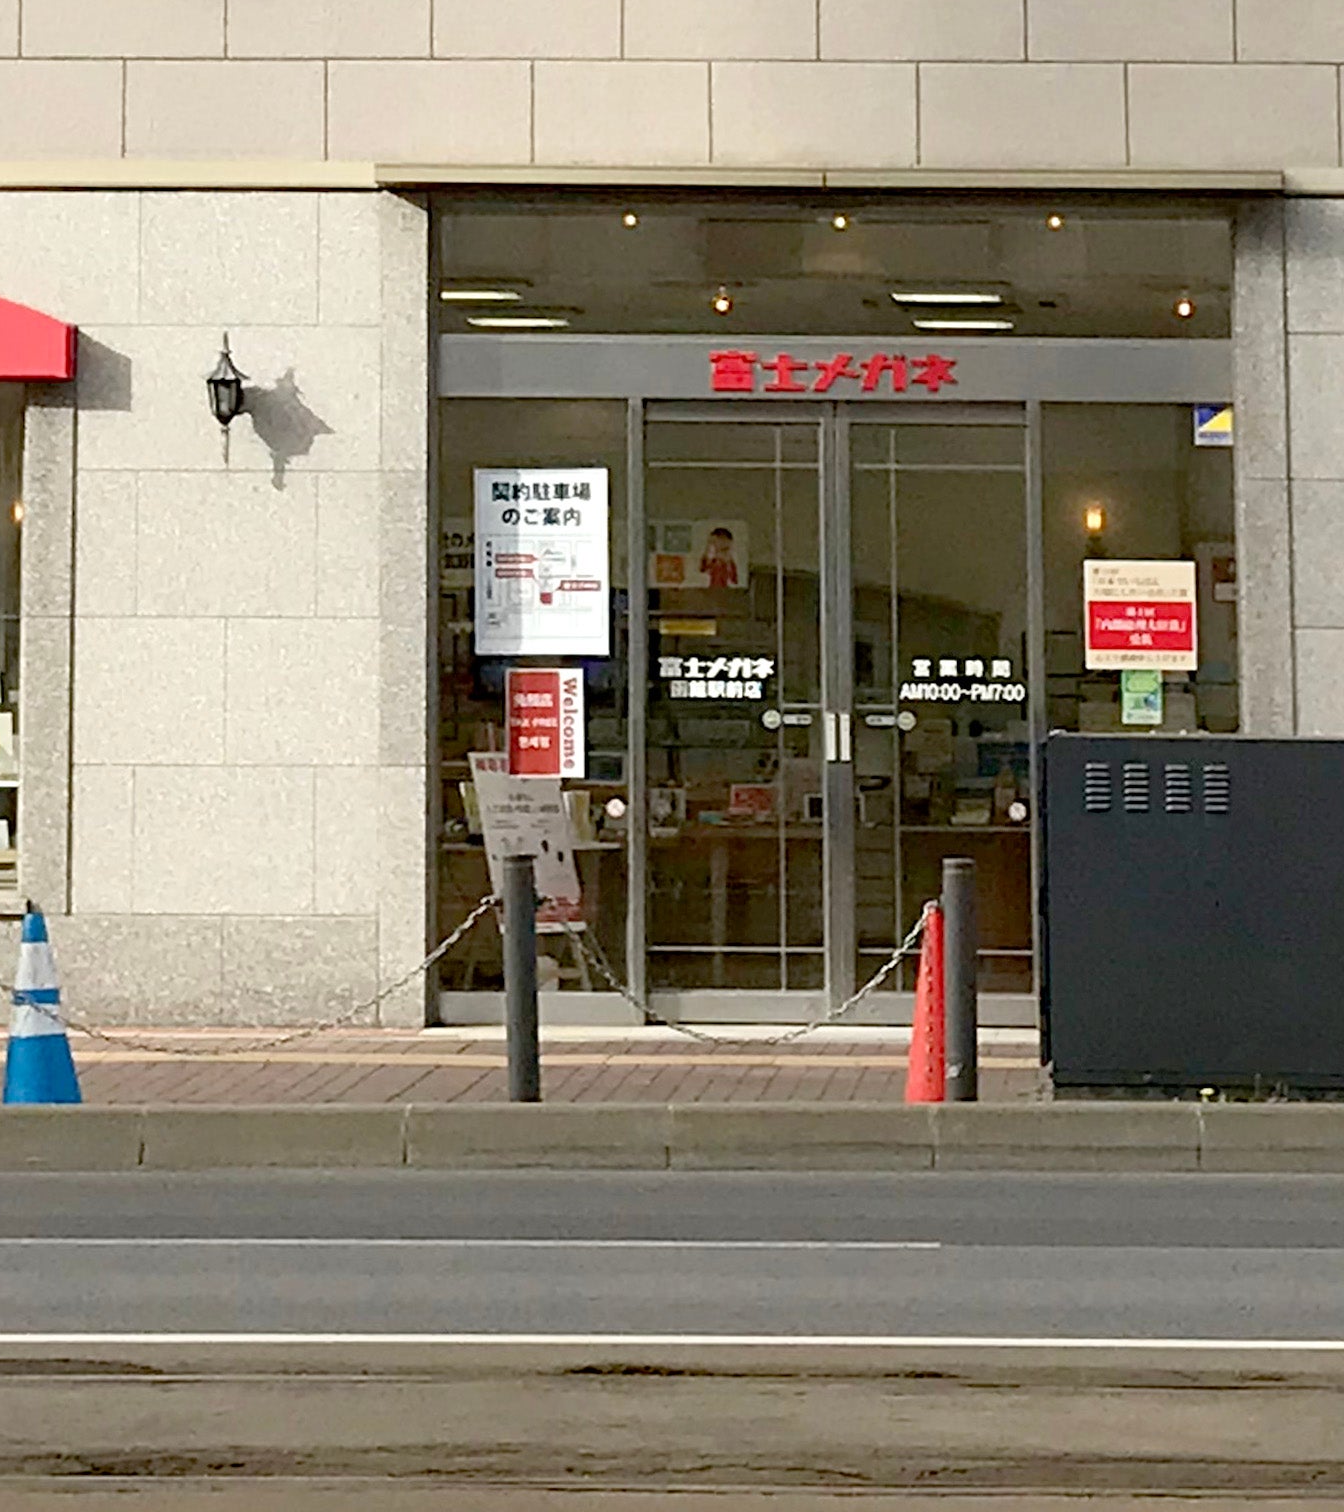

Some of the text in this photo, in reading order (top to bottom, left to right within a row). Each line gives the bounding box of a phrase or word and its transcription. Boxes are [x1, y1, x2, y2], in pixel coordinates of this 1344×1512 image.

[709, 350, 958, 393] 富士メガネ
[491, 481, 592, 502] 契約駐車場
[501, 507, 582, 527] のご案内
[658, 656, 775, 678] 富士メガネ
[911, 659, 1012, 678] 営業時間
[562, 676, 580, 771] Welcome
